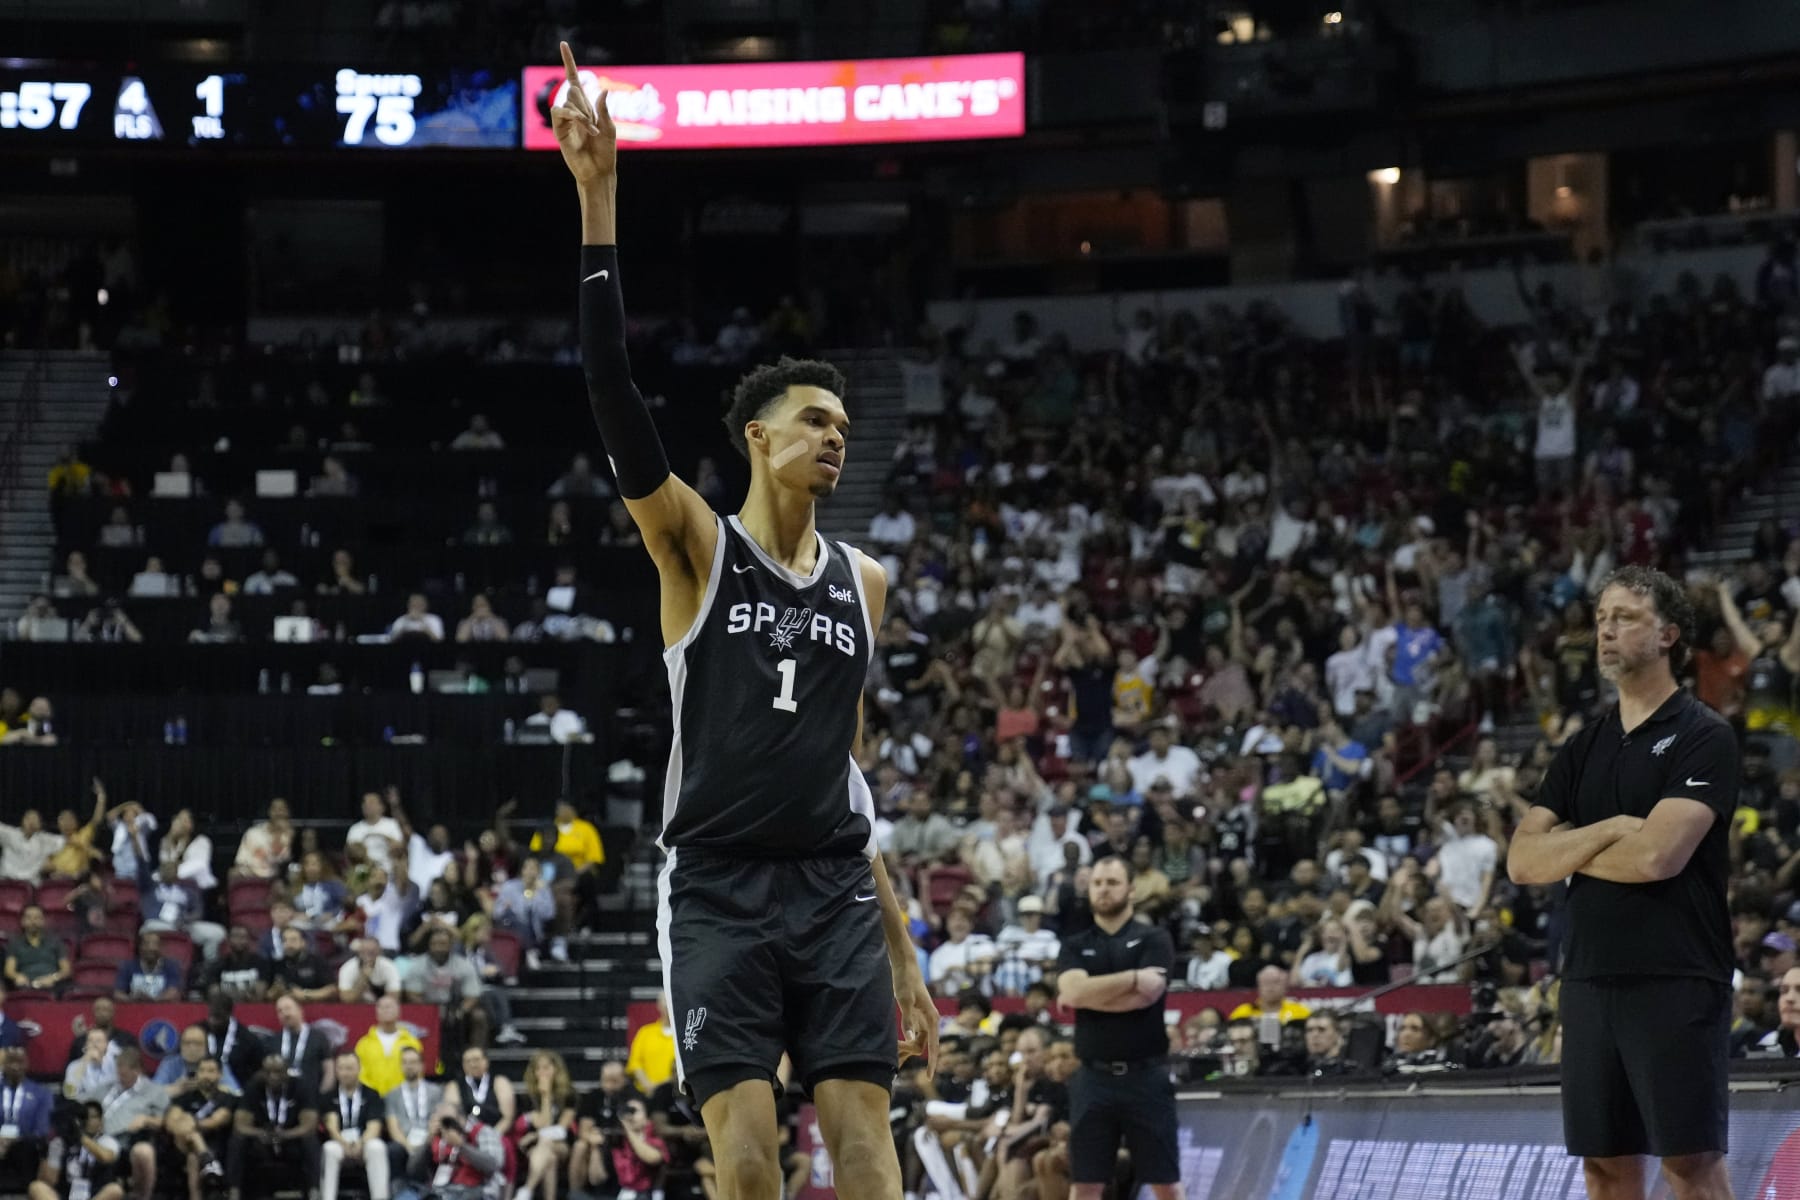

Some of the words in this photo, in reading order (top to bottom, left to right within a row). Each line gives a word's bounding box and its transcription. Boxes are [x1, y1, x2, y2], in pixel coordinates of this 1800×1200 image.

[118, 81, 148, 114] 4
[196, 75, 223, 116] 1
[676, 86, 847, 126] RAISING
[336, 95, 416, 145] 75
[727, 602, 856, 657] SPURS
[772, 658, 798, 713] 1
